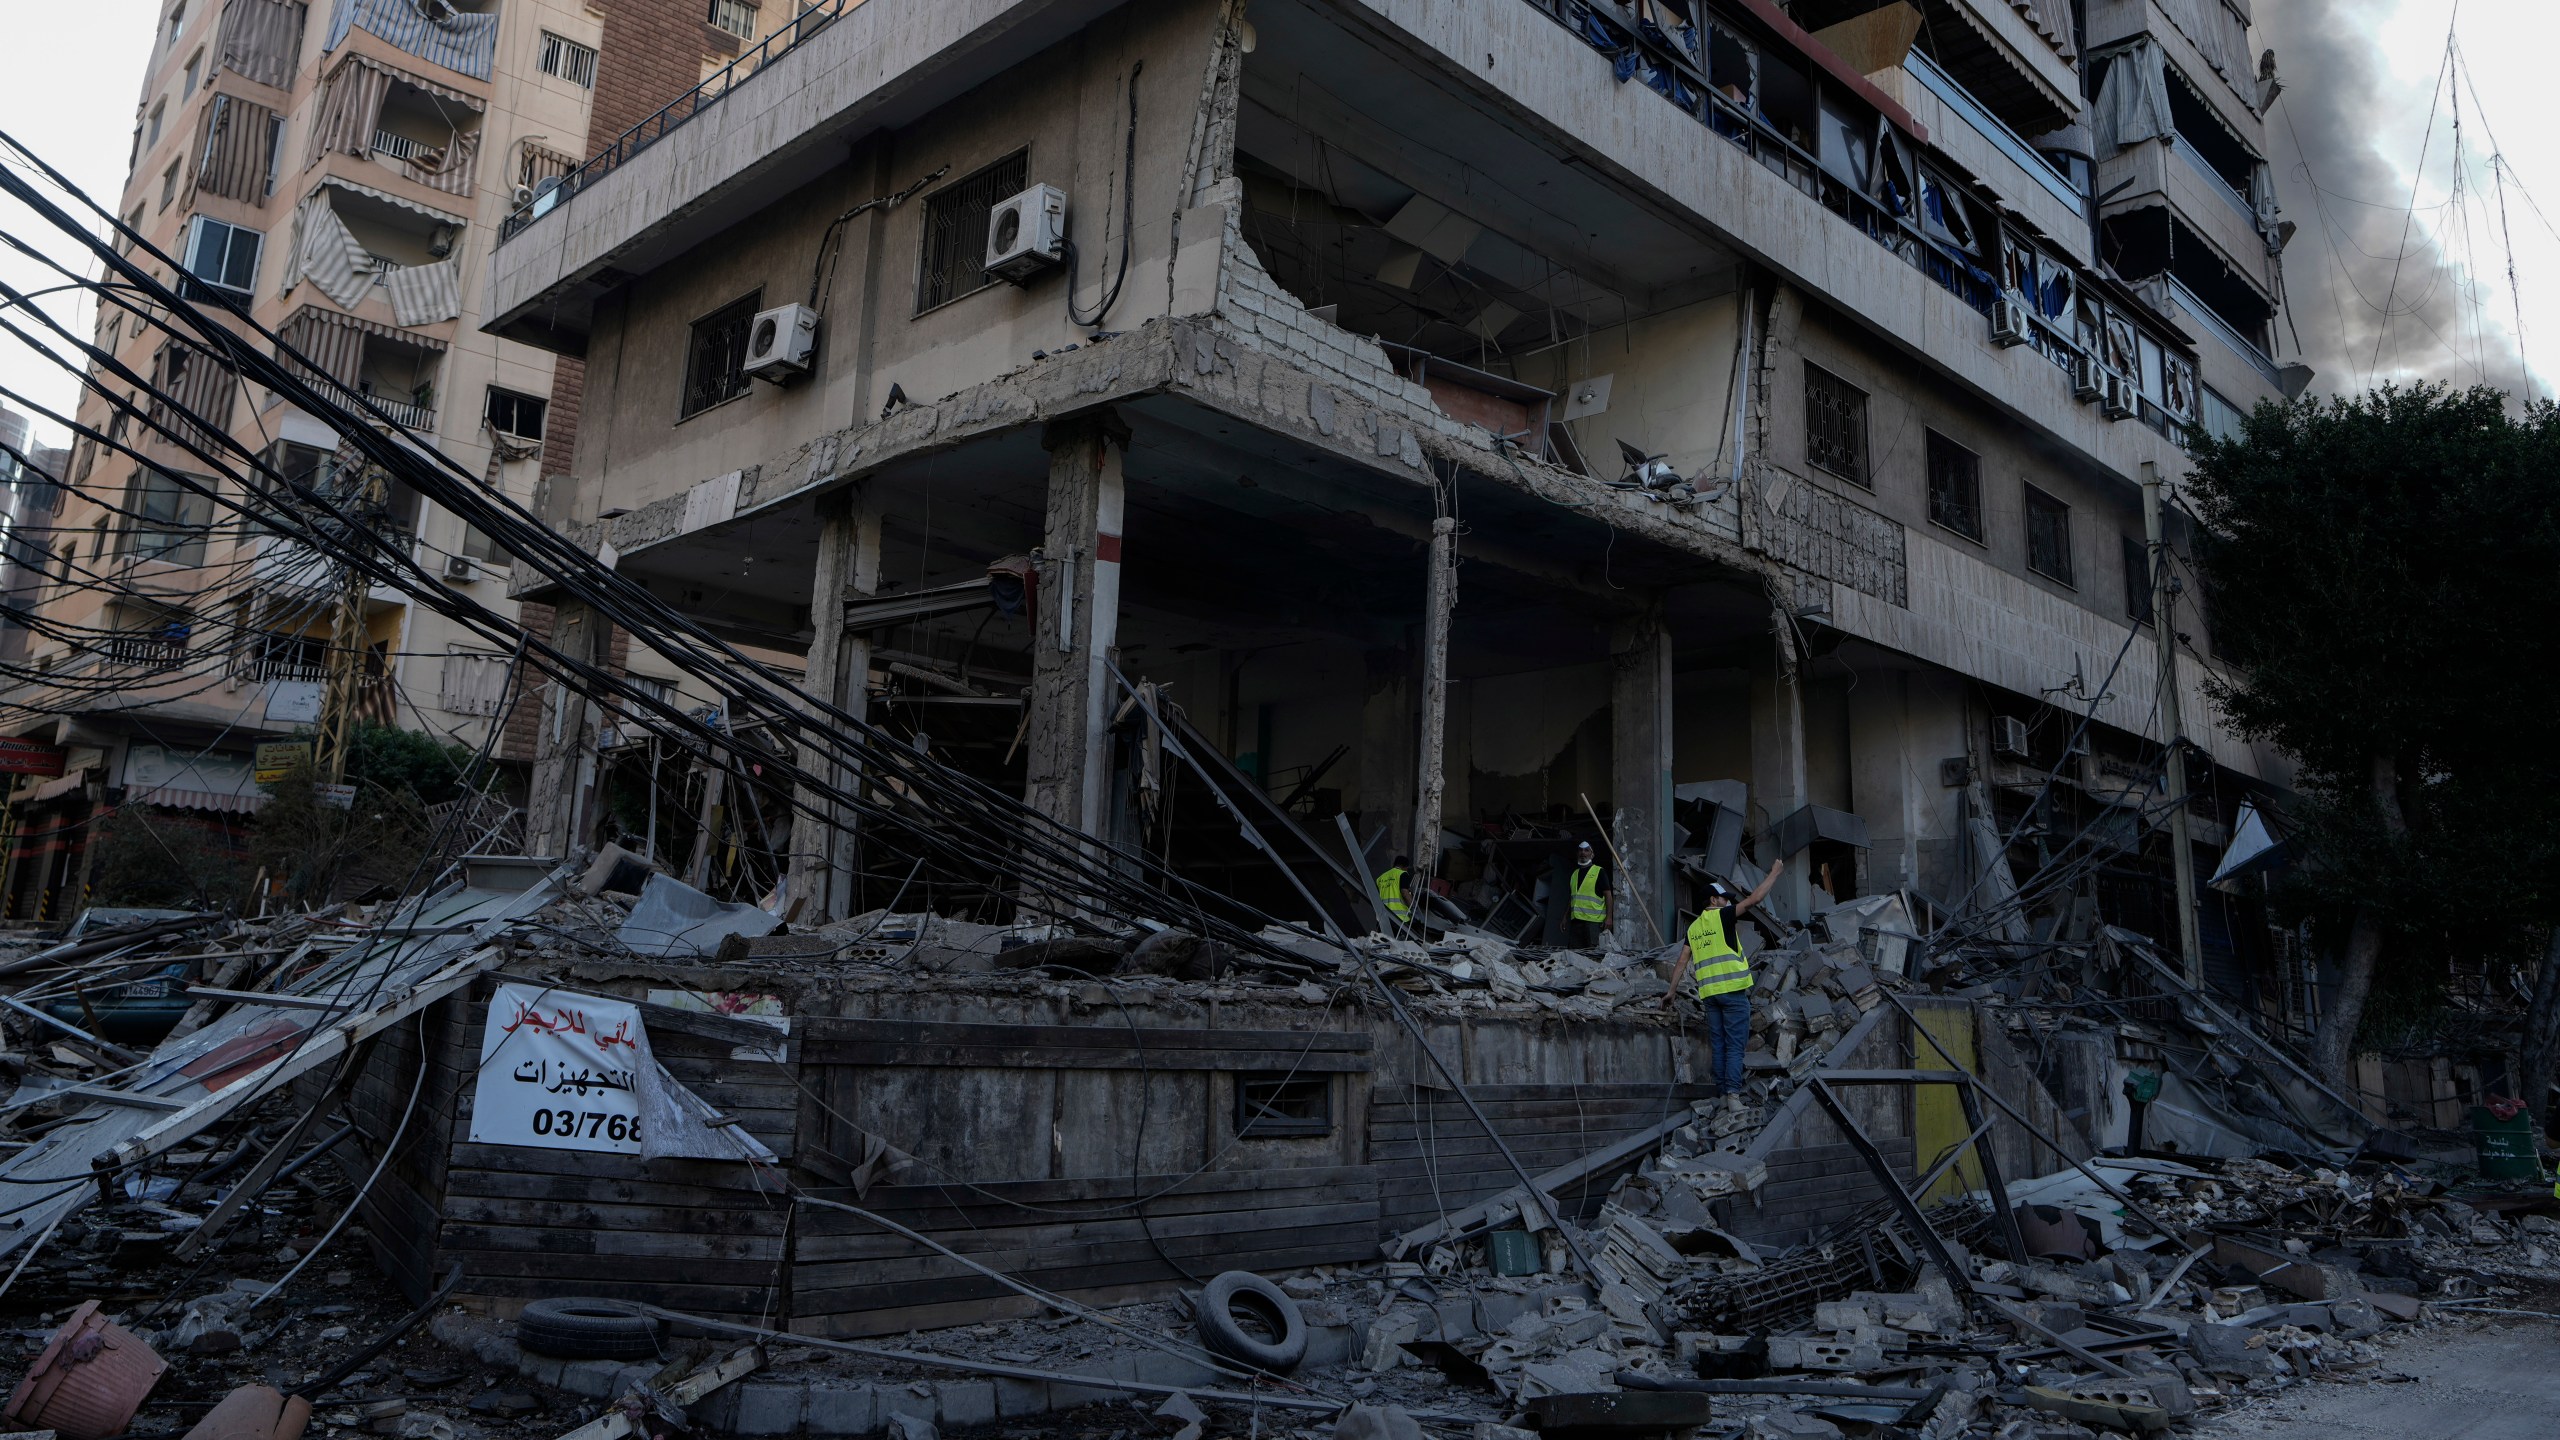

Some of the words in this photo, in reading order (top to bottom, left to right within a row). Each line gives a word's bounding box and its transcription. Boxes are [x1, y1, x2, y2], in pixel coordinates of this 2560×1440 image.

[264, 743, 302, 753] دهانات
[501, 1001, 586, 1039] للإيجار
[513, 1058, 635, 1097] التجهيزات
